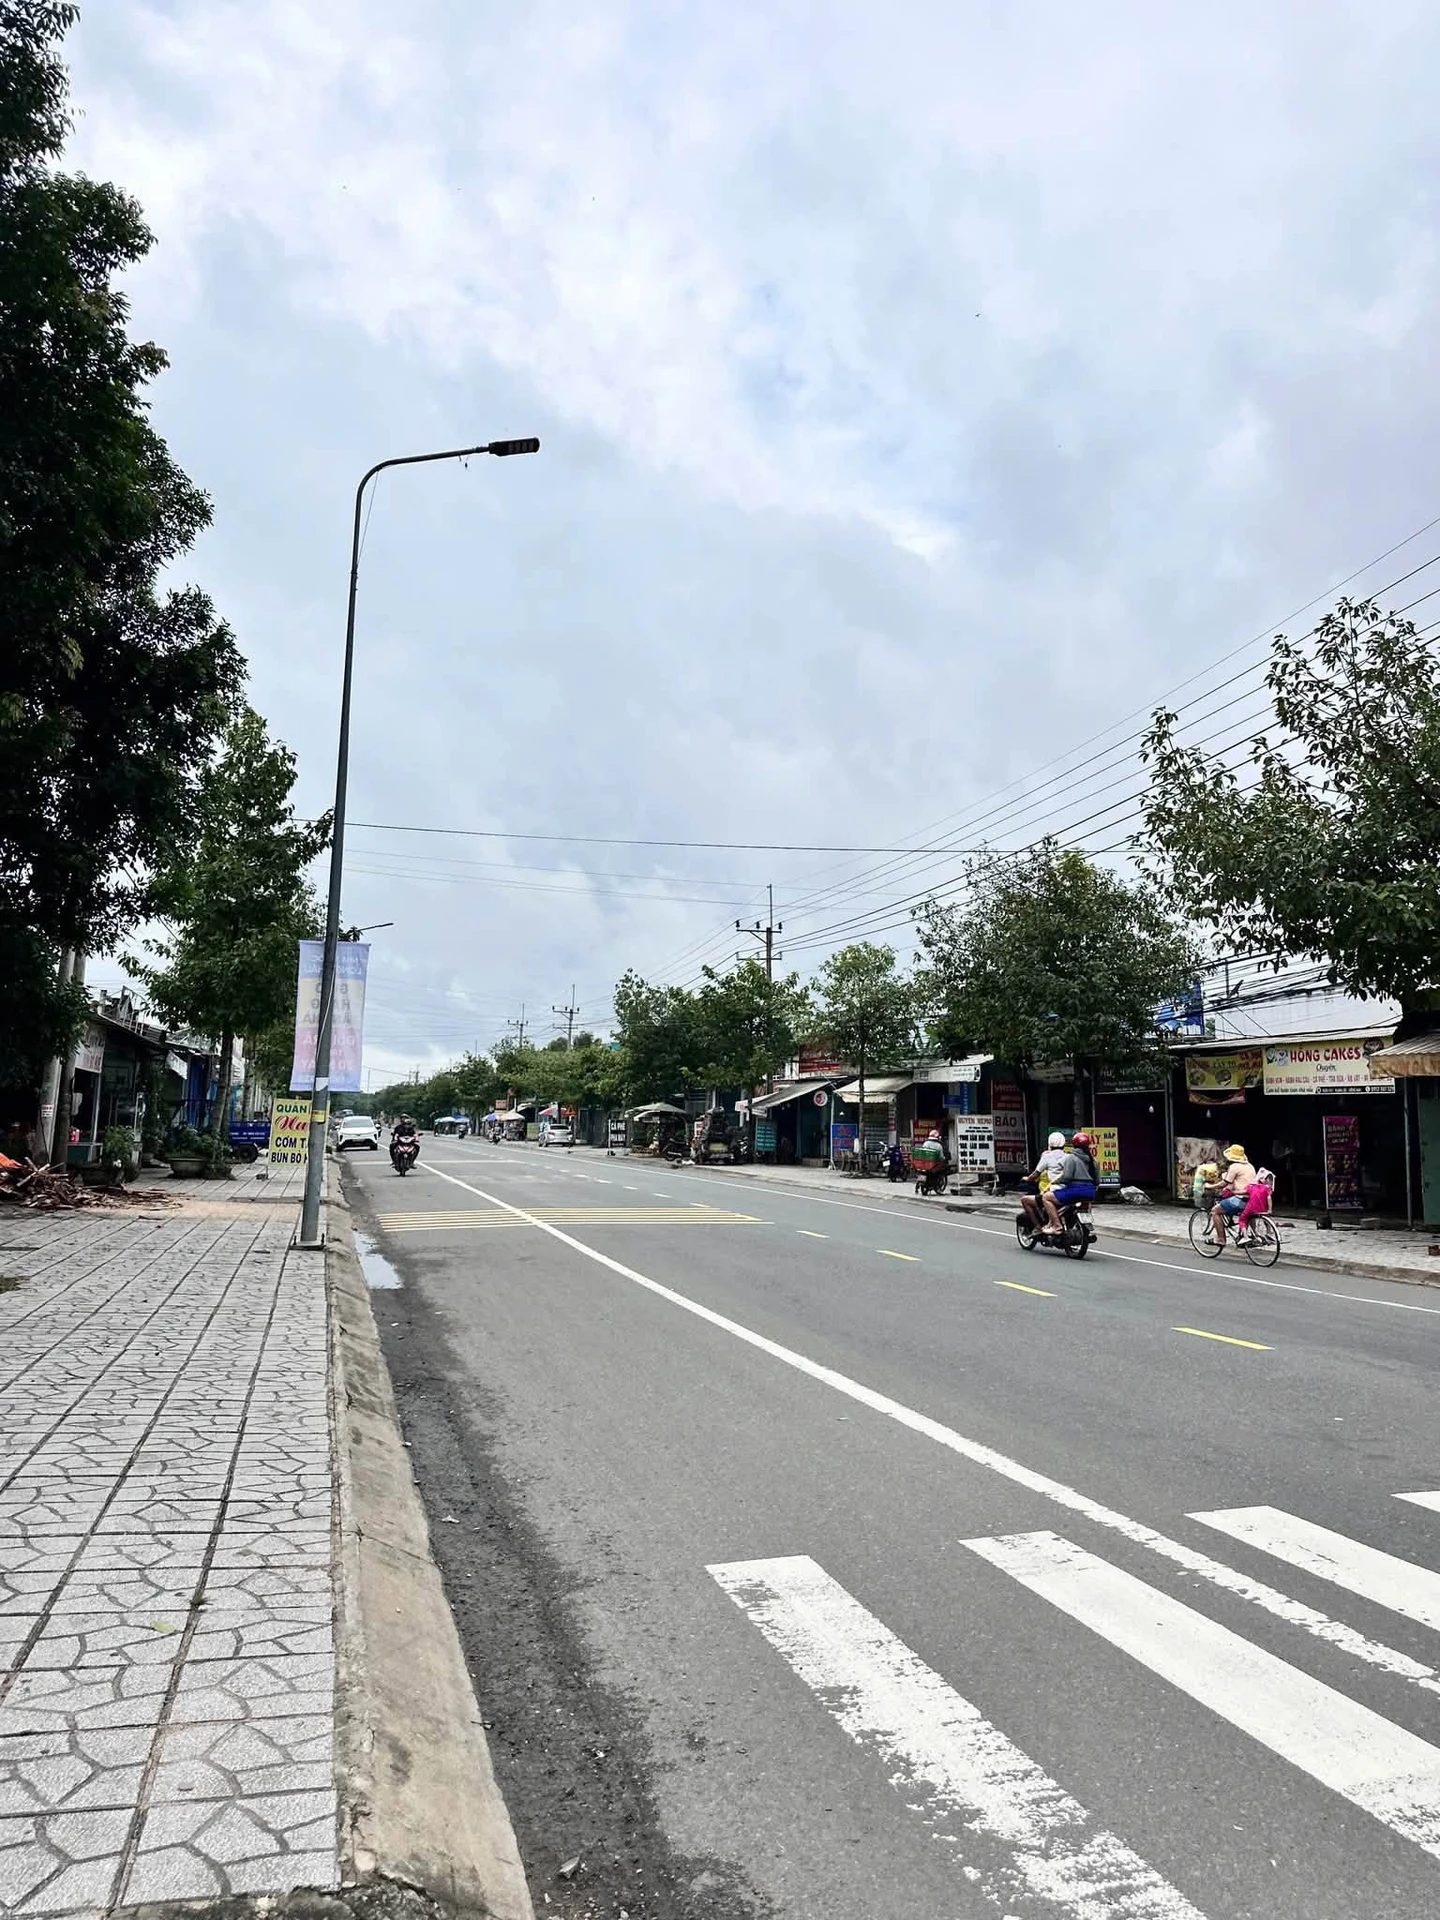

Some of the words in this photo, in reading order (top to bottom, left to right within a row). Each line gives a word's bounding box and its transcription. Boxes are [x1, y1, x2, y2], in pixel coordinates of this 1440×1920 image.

[1324, 1047, 1361, 1061] CAKES
[275, 1135, 297, 1148] CƠM
[271, 1149, 288, 1163] BÚN
